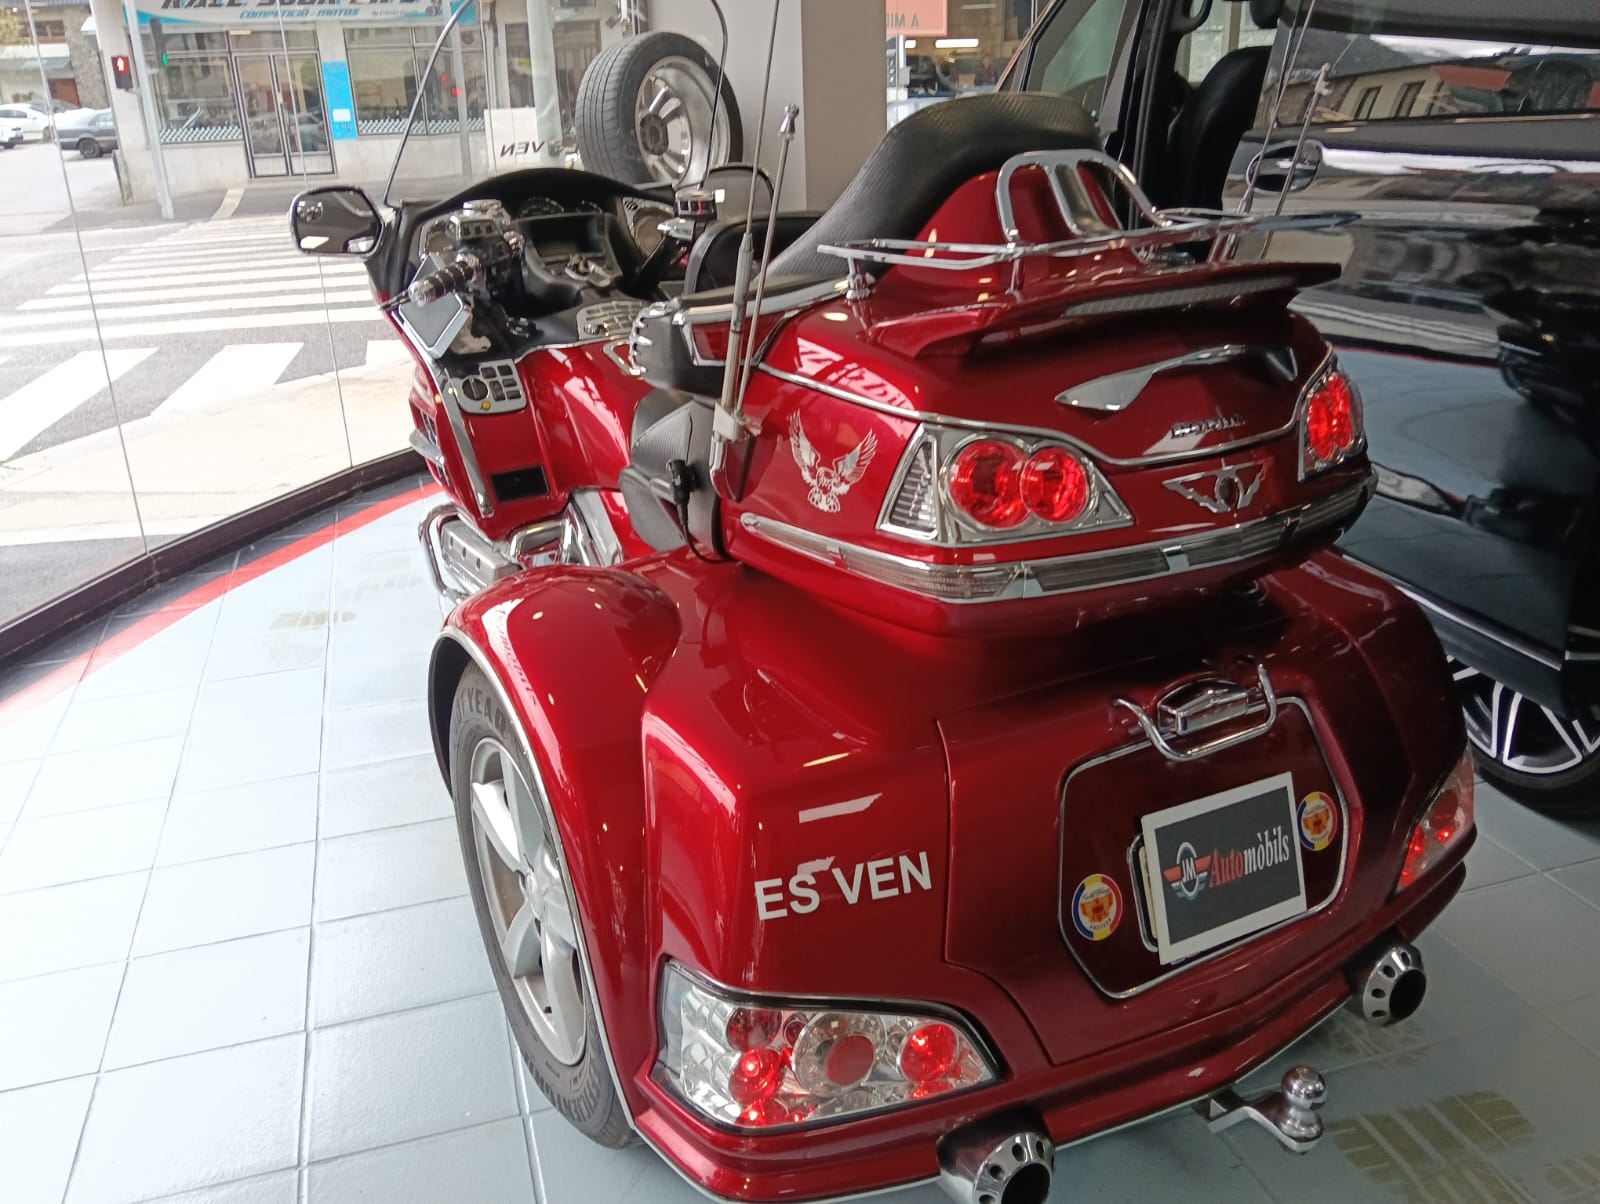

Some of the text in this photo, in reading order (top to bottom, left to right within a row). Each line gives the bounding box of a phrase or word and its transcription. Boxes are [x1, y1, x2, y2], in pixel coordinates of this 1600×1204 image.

[754, 851, 932, 921] ES VEN
[1209, 825, 1290, 888] Automòbils
